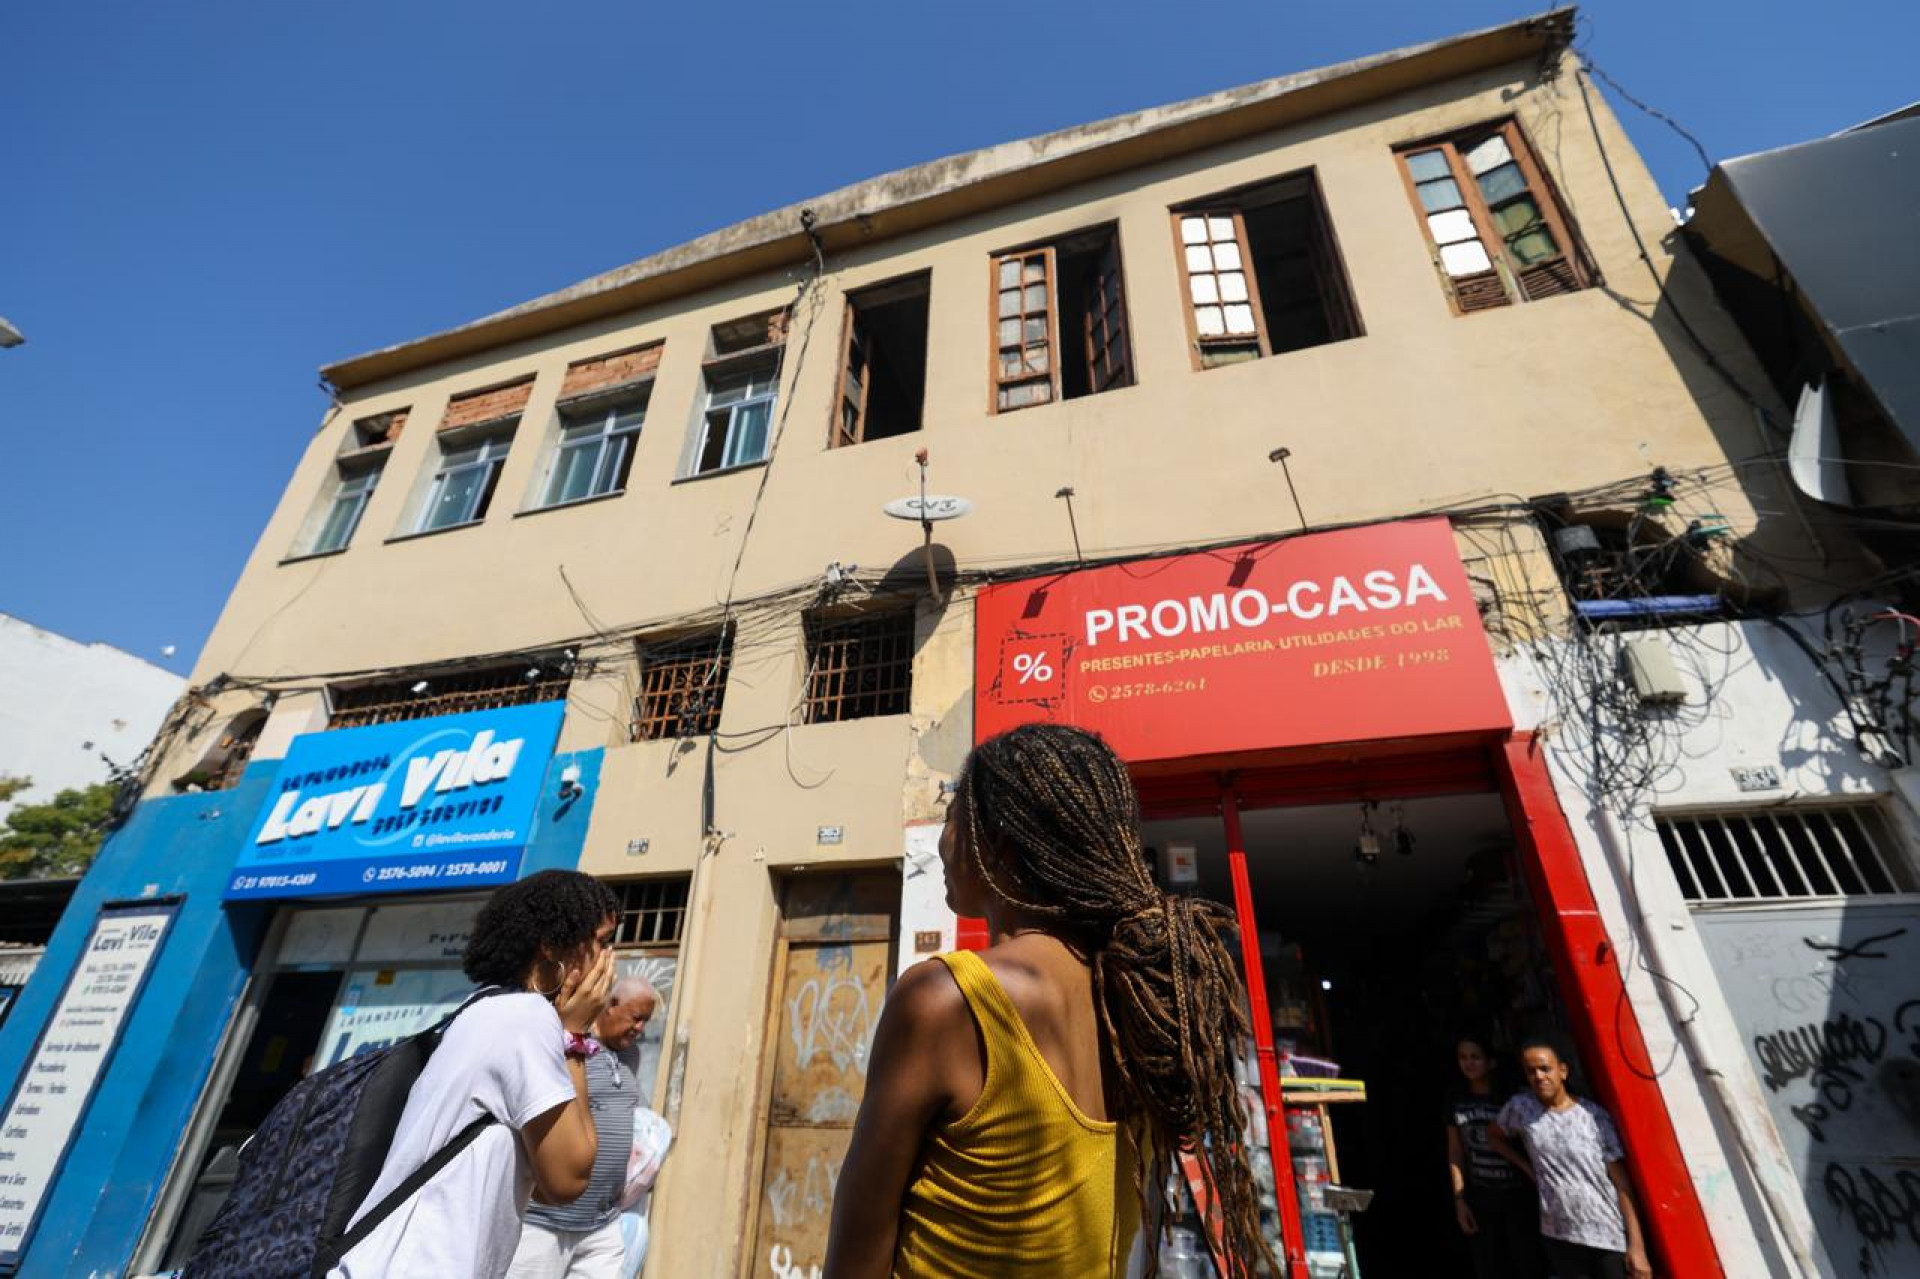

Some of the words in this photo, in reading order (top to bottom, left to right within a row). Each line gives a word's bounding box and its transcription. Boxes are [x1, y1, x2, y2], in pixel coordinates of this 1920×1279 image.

[1086, 564, 1448, 646] PROMO-CASA
[1390, 620, 1418, 635] DO
[1422, 615, 1464, 630] LAR
[1013, 651, 1054, 684] %
[1313, 655, 1388, 678] DESDE
[1397, 649, 1449, 668] 1998
[256, 782, 386, 845] Lavi
[400, 729, 525, 808] Vila
[92, 931, 127, 951] Lavi
[129, 924, 159, 941] Vila
